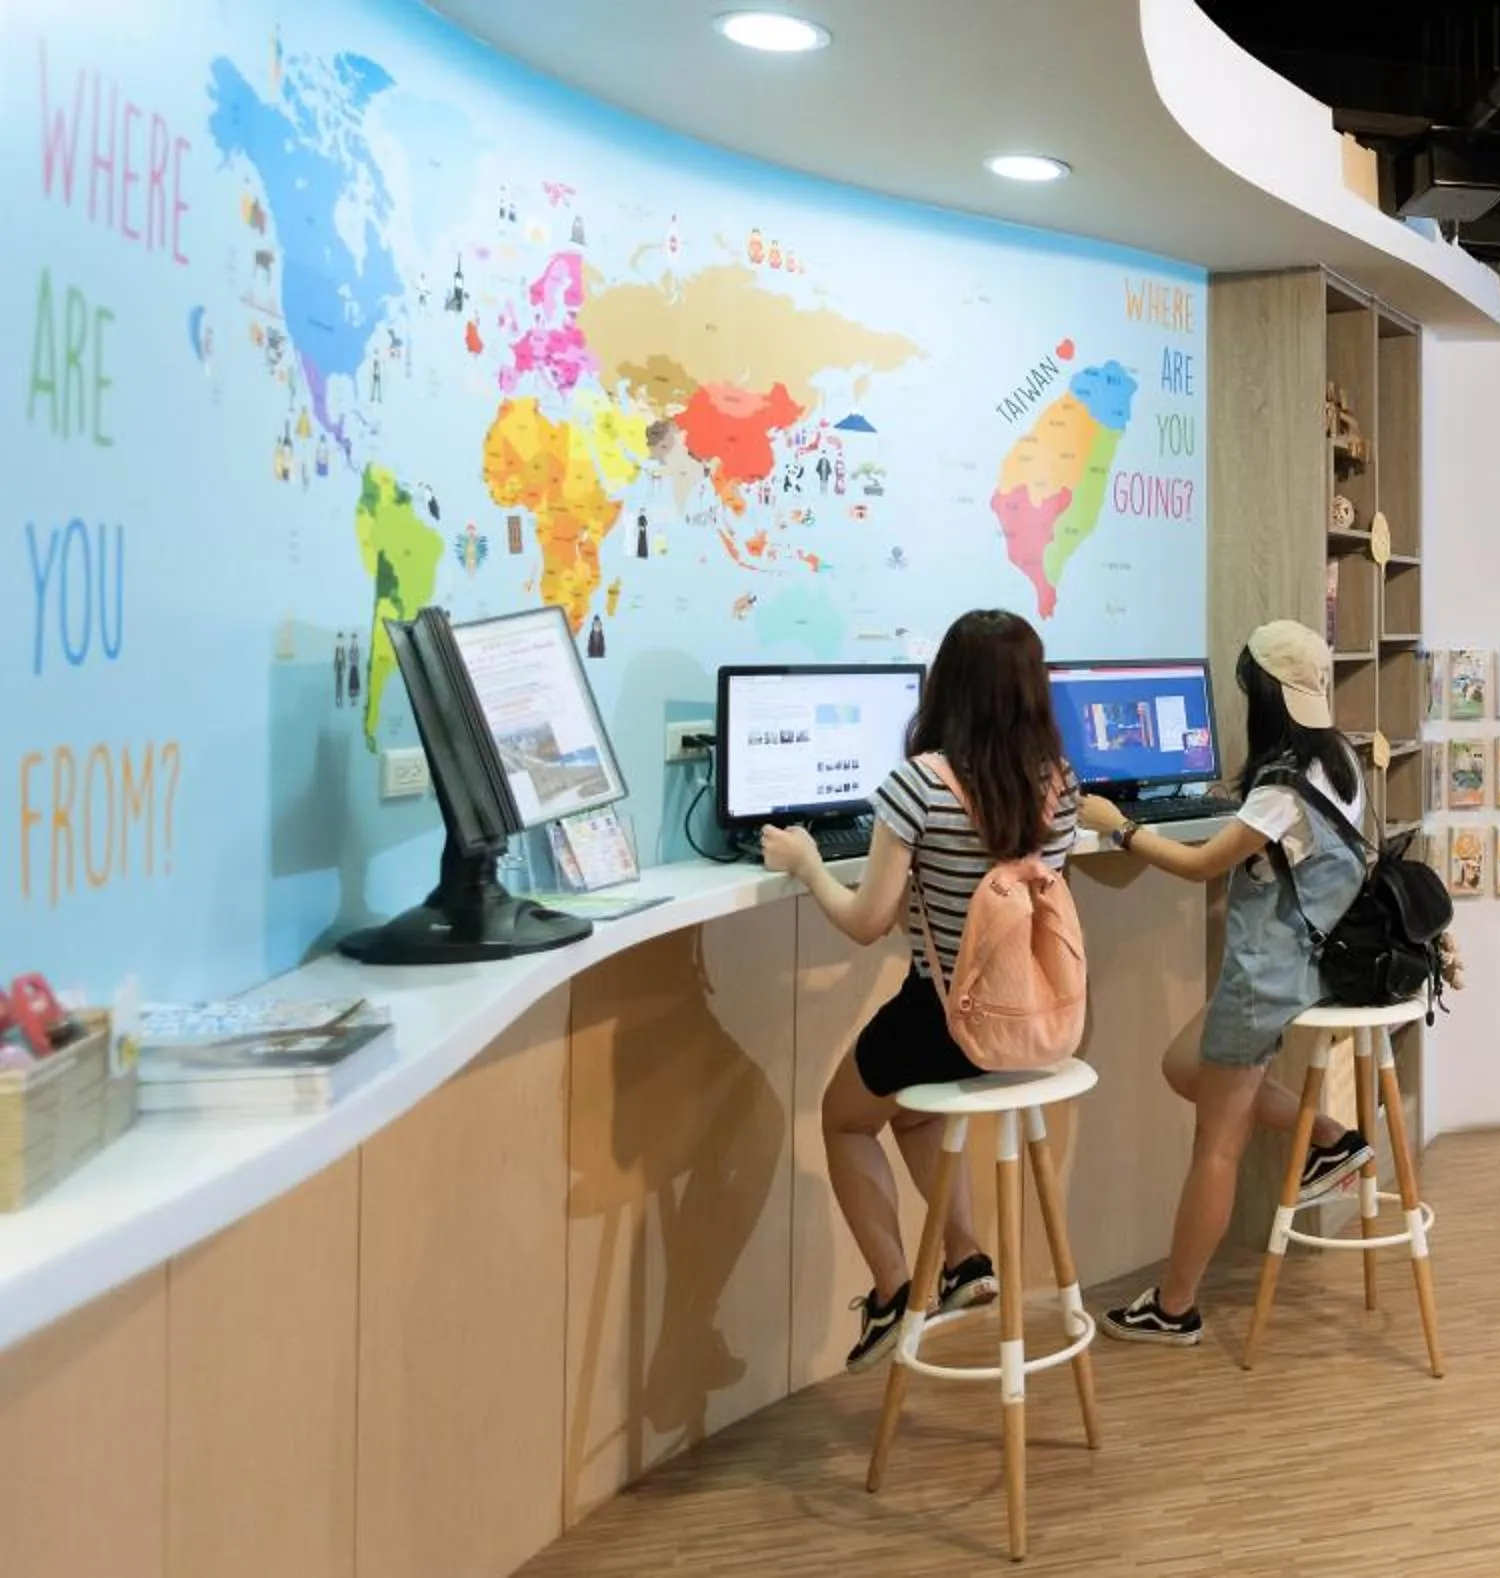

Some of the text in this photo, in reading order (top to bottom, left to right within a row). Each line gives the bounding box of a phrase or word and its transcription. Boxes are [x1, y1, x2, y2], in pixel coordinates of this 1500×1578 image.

[38, 34, 192, 267] WHERE
[1124, 275, 1195, 334] WHERE
[26, 263, 116, 448] ARE
[995, 355, 1060, 425] TAIWAN
[1160, 345, 1194, 397] ARE
[1156, 413, 1195, 457] YOU
[1112, 471, 1194, 522] GOING?
[25, 517, 126, 678] YOU
[18, 737, 182, 911] FROM?
